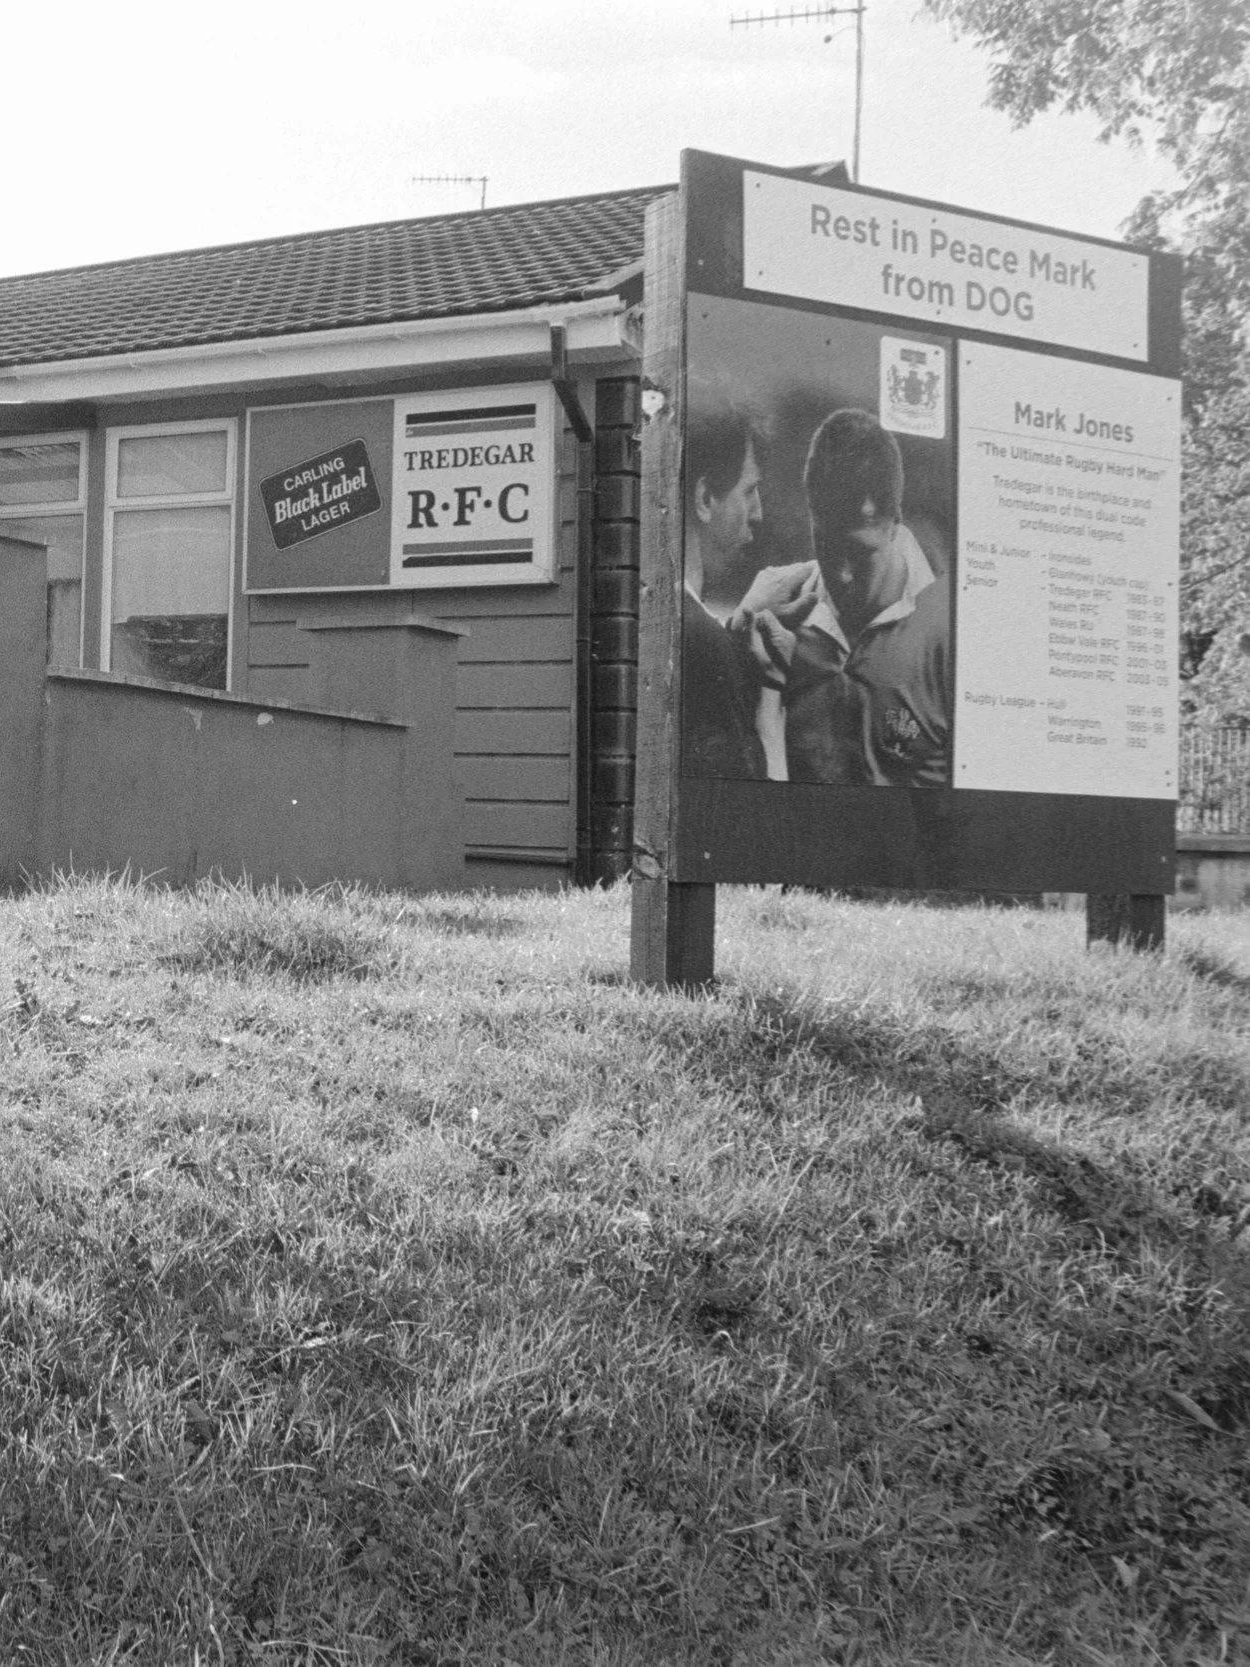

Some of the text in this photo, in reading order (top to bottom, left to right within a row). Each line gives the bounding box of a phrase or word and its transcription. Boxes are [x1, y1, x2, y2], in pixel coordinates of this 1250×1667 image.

[811, 203, 1097, 291] Rest in Peace Mark
[882, 264, 1034, 321] from DOG
[1014, 401, 1134, 442] Mark Jones
[404, 443, 535, 471] TREDEGAR
[1010, 446, 1062, 466] Ultimate
[1066, 454, 1104, 474] Rugby
[1106, 461, 1133, 477] Hard
[284, 457, 345, 491] CARLING
[273, 467, 368, 525] Black Label
[993, 475, 1151, 510] Tredegar is the birthplace and
[301, 502, 351, 532] LAGER
[998, 495, 1146, 527] hometown of this dual code
[1019, 518, 1085, 537] professional
[966, 540, 988, 553] Mini
[990, 543, 997, 554] &
[999, 546, 1031, 558] Junior
[966, 556, 996, 570] Youth
[965, 574, 998, 588] Senior
[1048, 583, 1091, 600] Tredegar
[964, 691, 997, 707] Rugby
[1000, 694, 1036, 708] League
[1047, 715, 1102, 730] Warrington
[1047, 731, 1074, 744] Great
[1076, 733, 1108, 745] Britain
